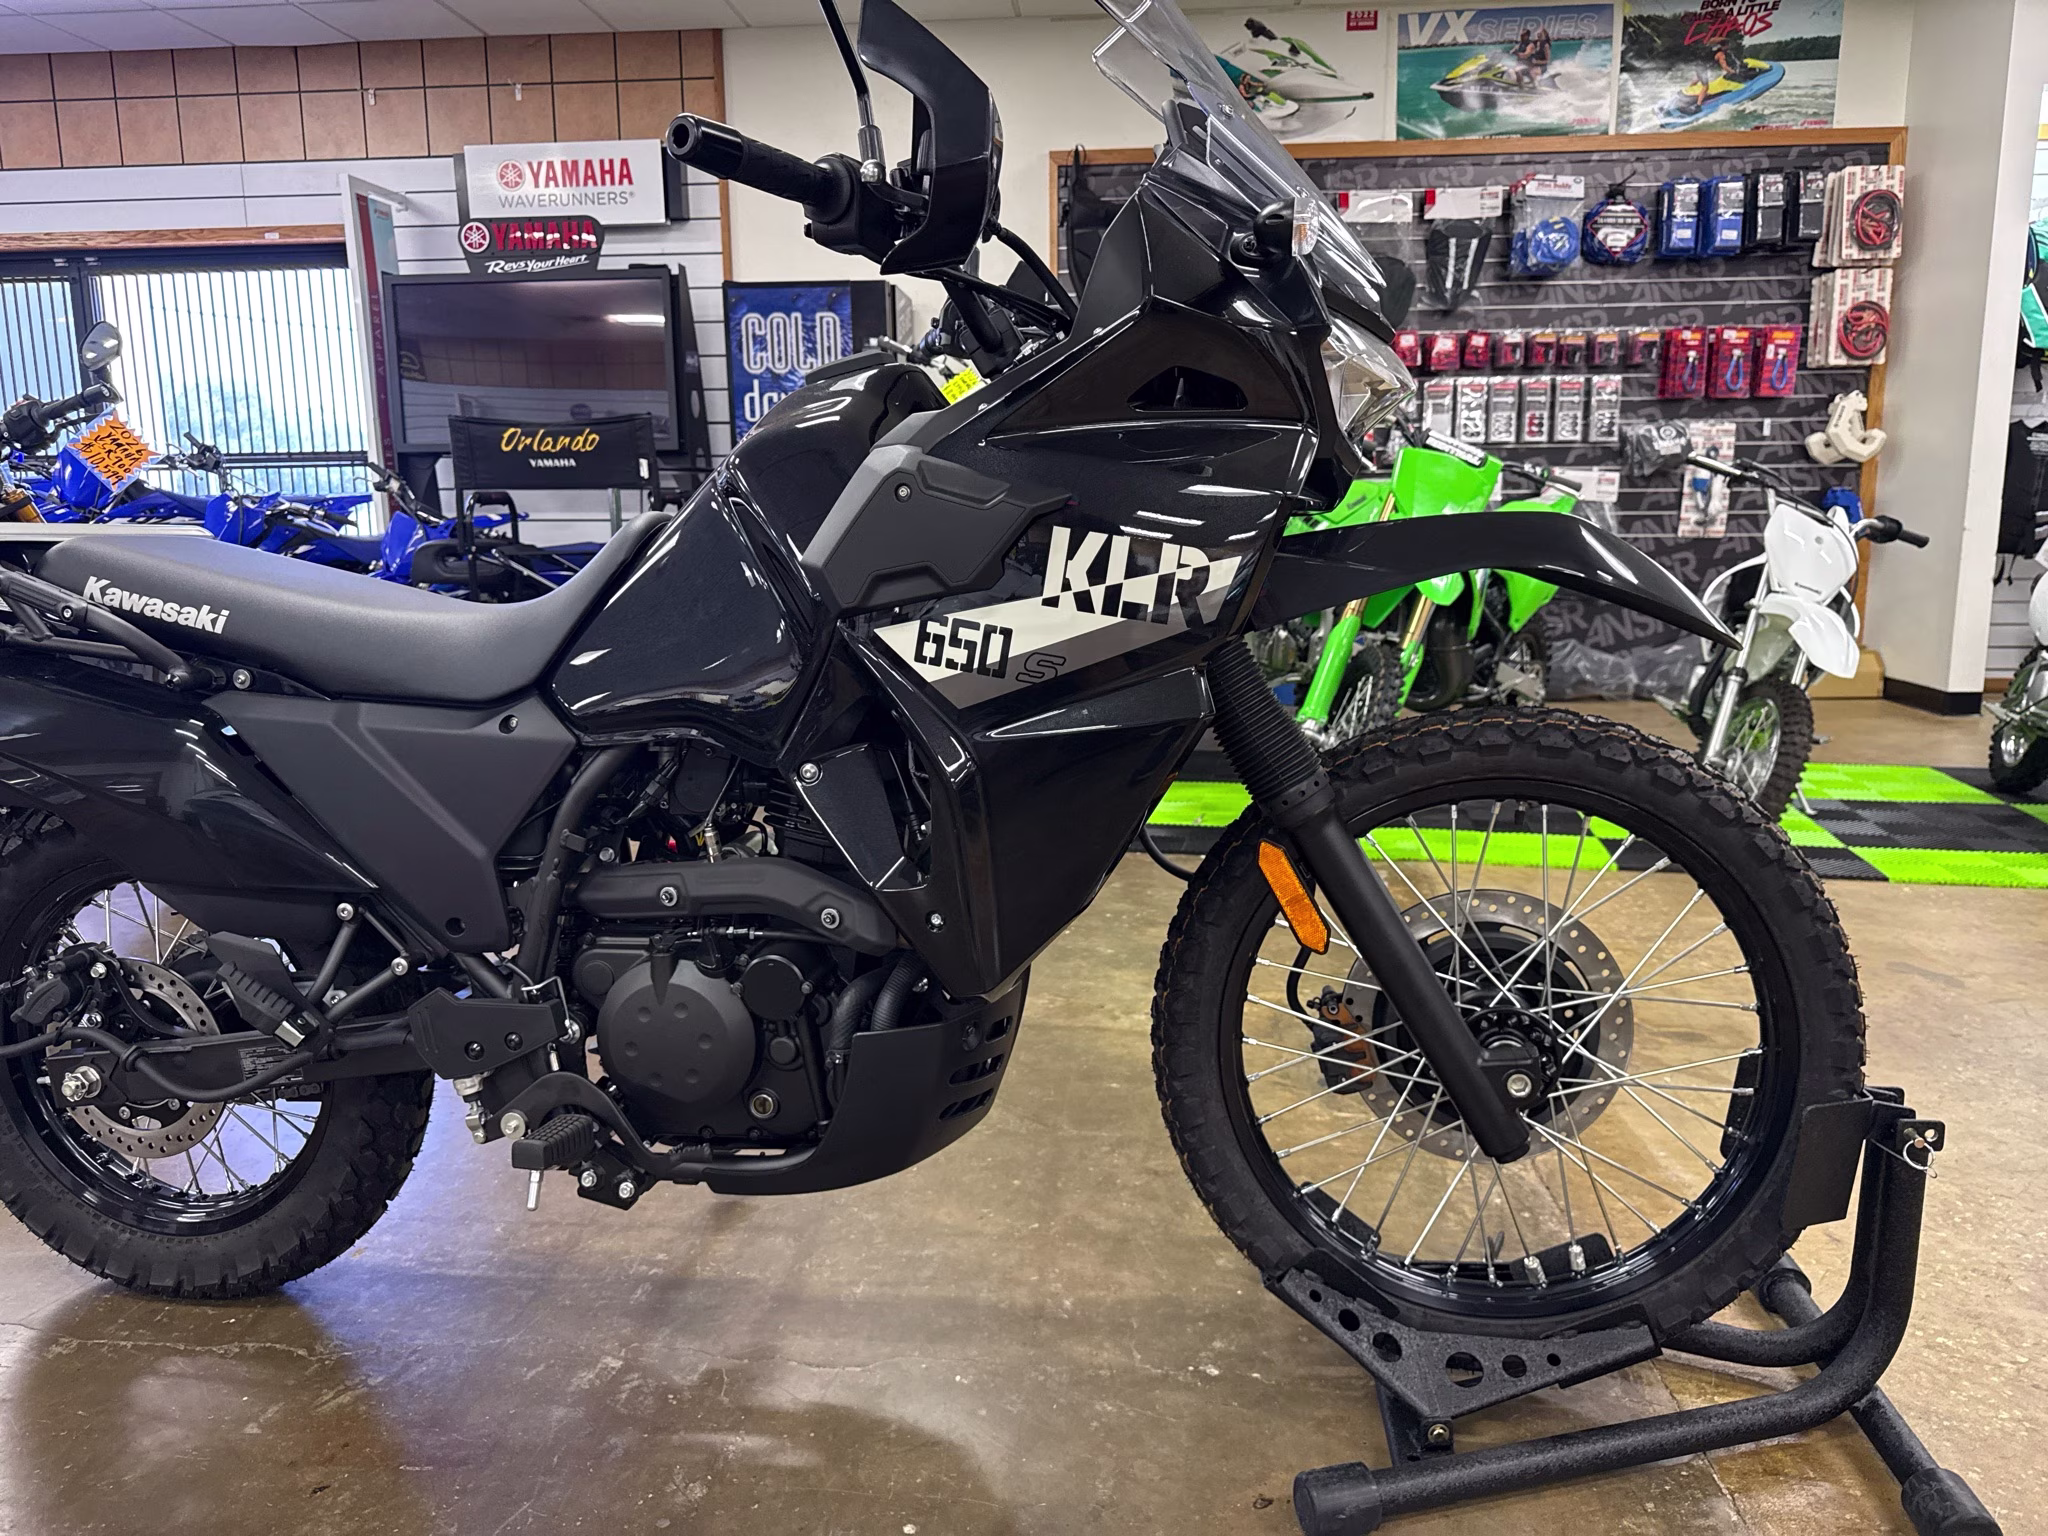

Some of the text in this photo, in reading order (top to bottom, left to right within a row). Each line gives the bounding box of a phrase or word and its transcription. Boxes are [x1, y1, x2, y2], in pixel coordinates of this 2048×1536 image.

[1737, 0, 1782, 16] LITTLE
[1407, 10, 1477, 46] VX
[527, 158, 634, 189] YAMAHA
[491, 220, 597, 251] YAMAHA
[741, 311, 841, 374] COLD
[501, 427, 600, 453] Orlando
[529, 458, 576, 468] YAMAHA
[1041, 525, 1212, 629] KLR
[83, 575, 230, 635] Kawasaki
[914, 615, 1014, 679] 650
